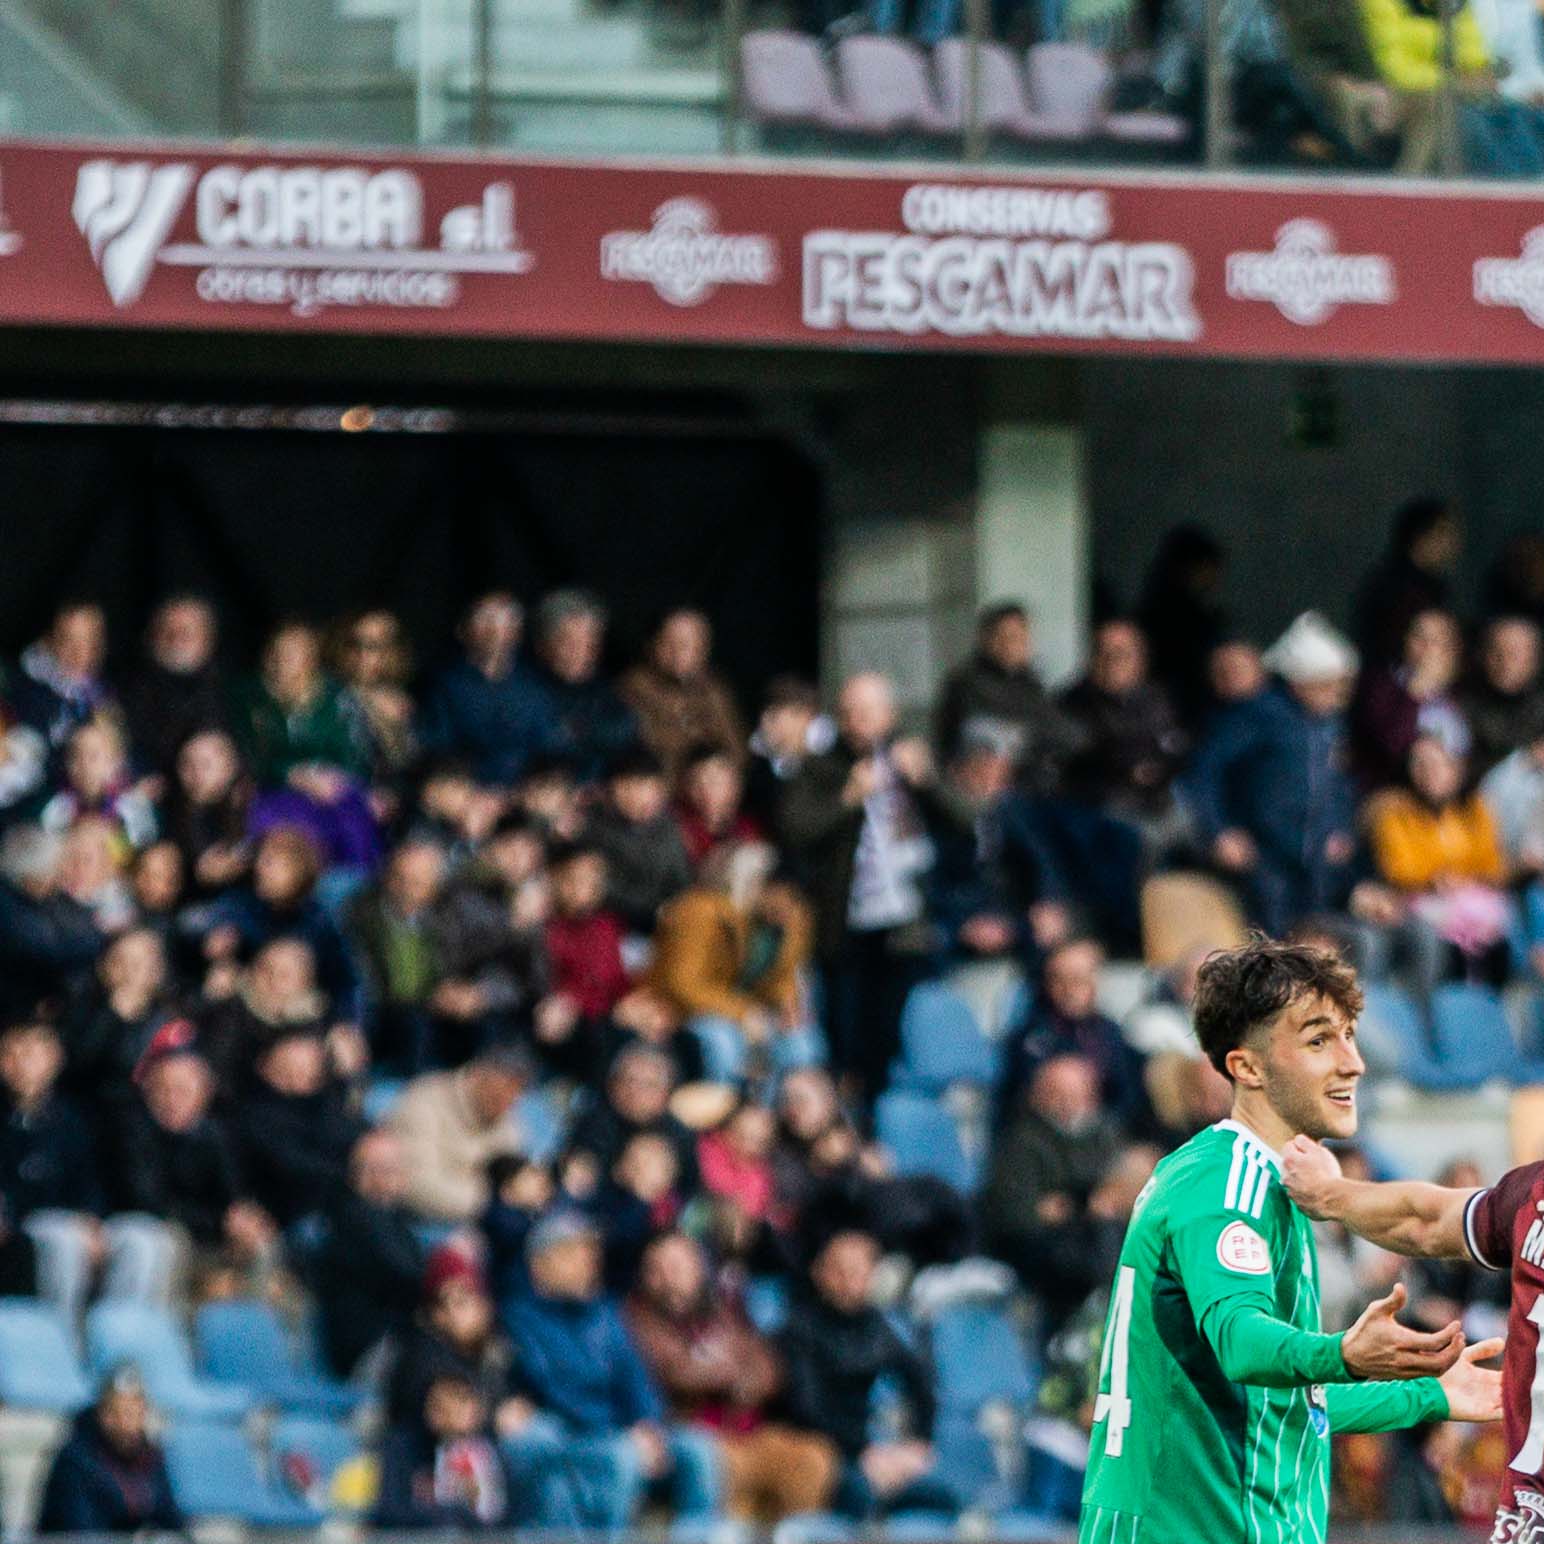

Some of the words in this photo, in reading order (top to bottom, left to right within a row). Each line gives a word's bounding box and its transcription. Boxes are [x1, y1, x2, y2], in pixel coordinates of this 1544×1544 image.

[197, 165, 424, 248] CORBA
[903, 185, 1109, 238] CONSERVAS
[802, 230, 1198, 338] PESCAMAR
